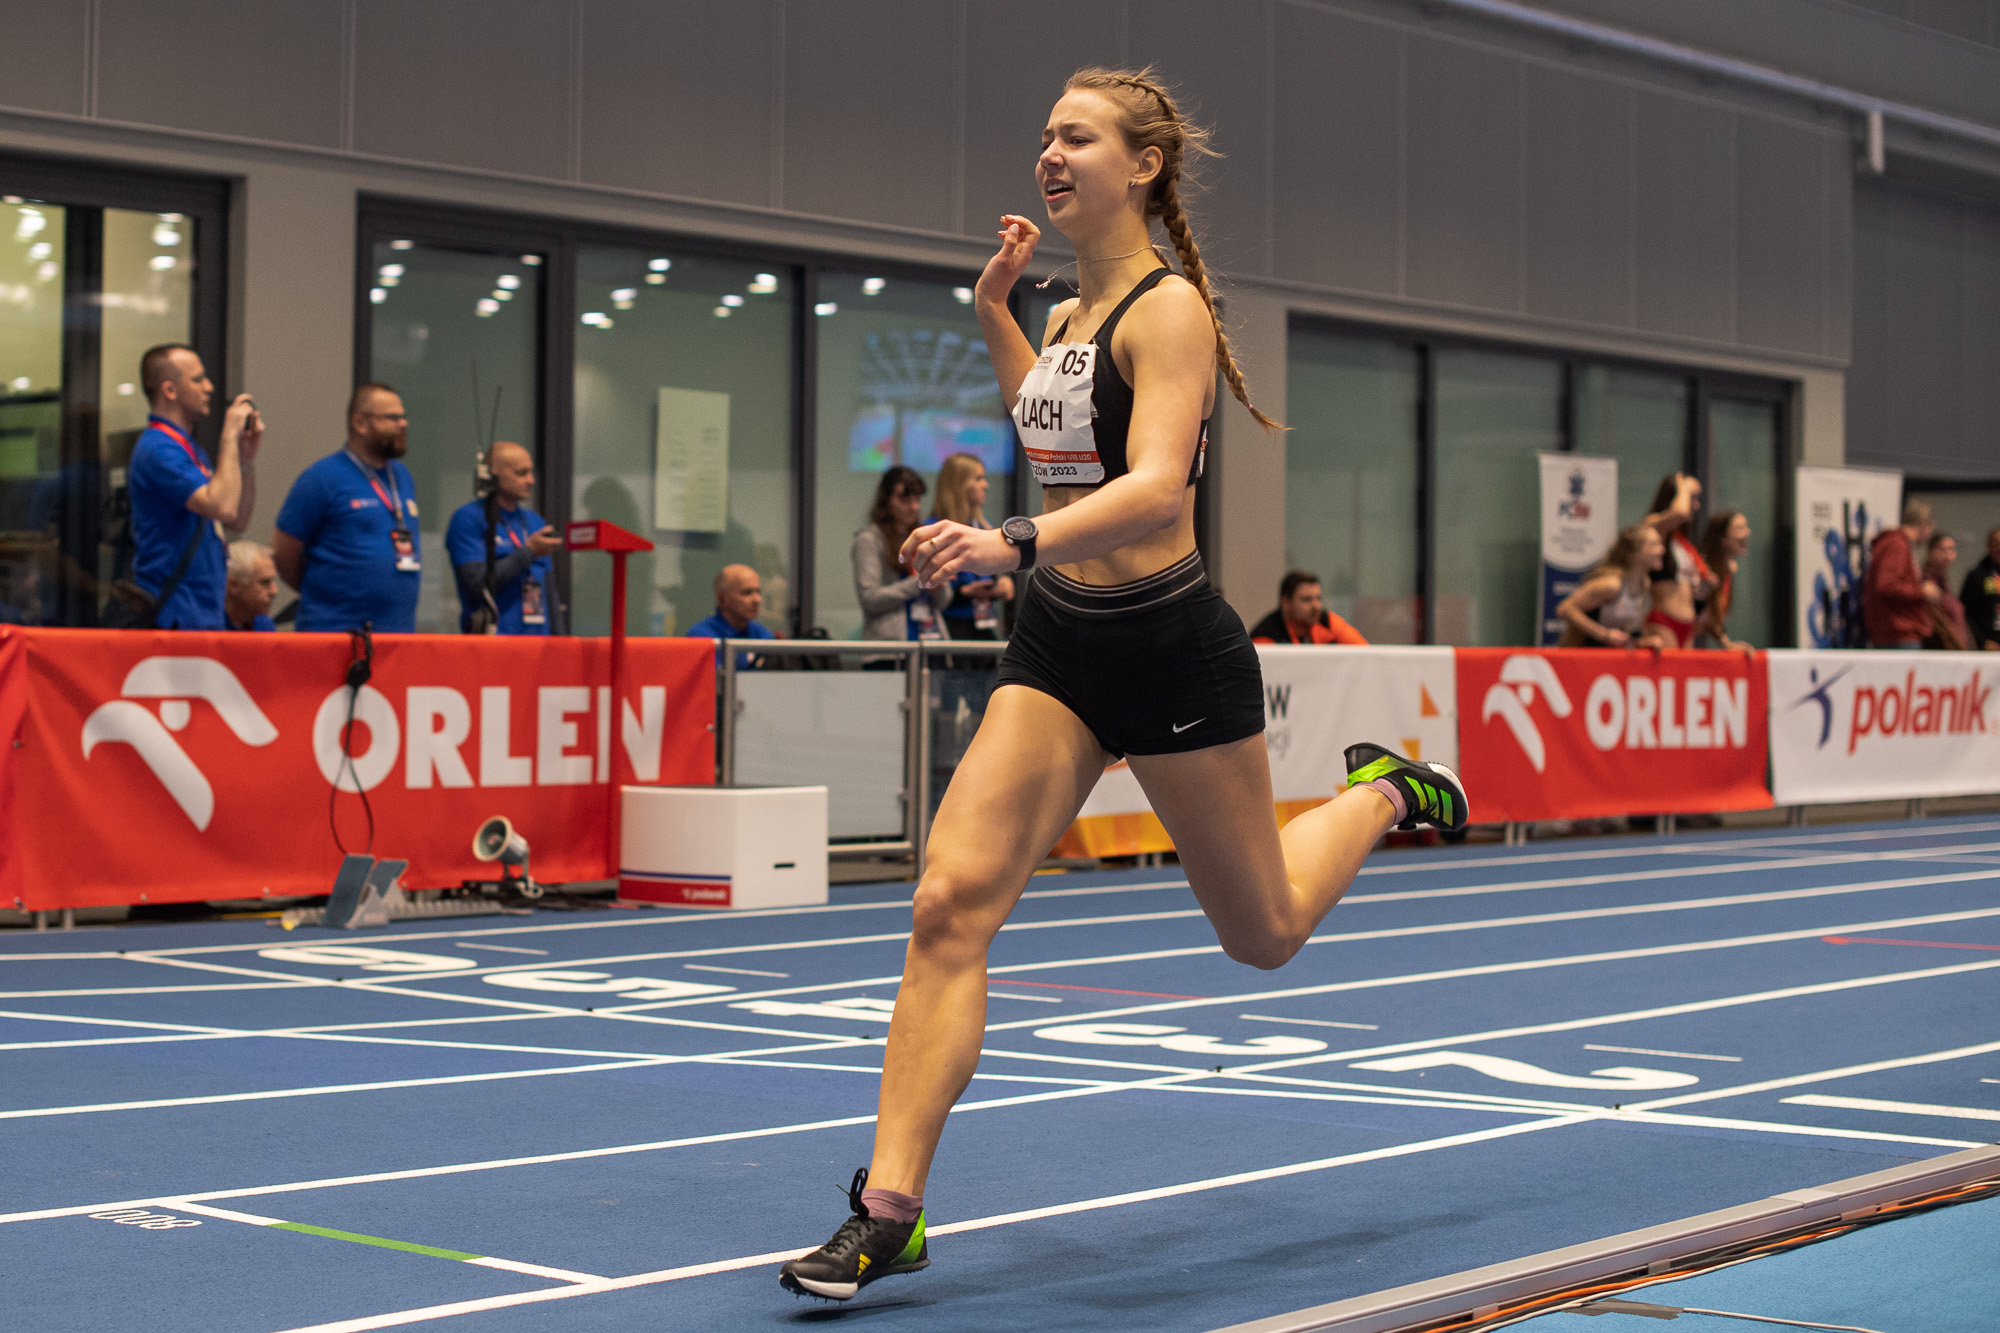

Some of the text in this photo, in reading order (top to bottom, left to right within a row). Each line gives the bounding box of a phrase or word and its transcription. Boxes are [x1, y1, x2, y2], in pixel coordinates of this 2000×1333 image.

[1055, 349, 1090, 376] 05
[1022, 397, 1063, 431] LACH
[1050, 466, 1078, 476] 2023
[1079, 453, 1092, 461] U20
[1585, 674, 1749, 751] ORLEN
[1847, 669, 1991, 755] polanik
[312, 685, 667, 793] ORLEN
[482, 971, 738, 999] 5
[1033, 1023, 1328, 1057] 3
[1348, 1050, 1699, 1091] 2
[88, 1209, 203, 1230] 800
